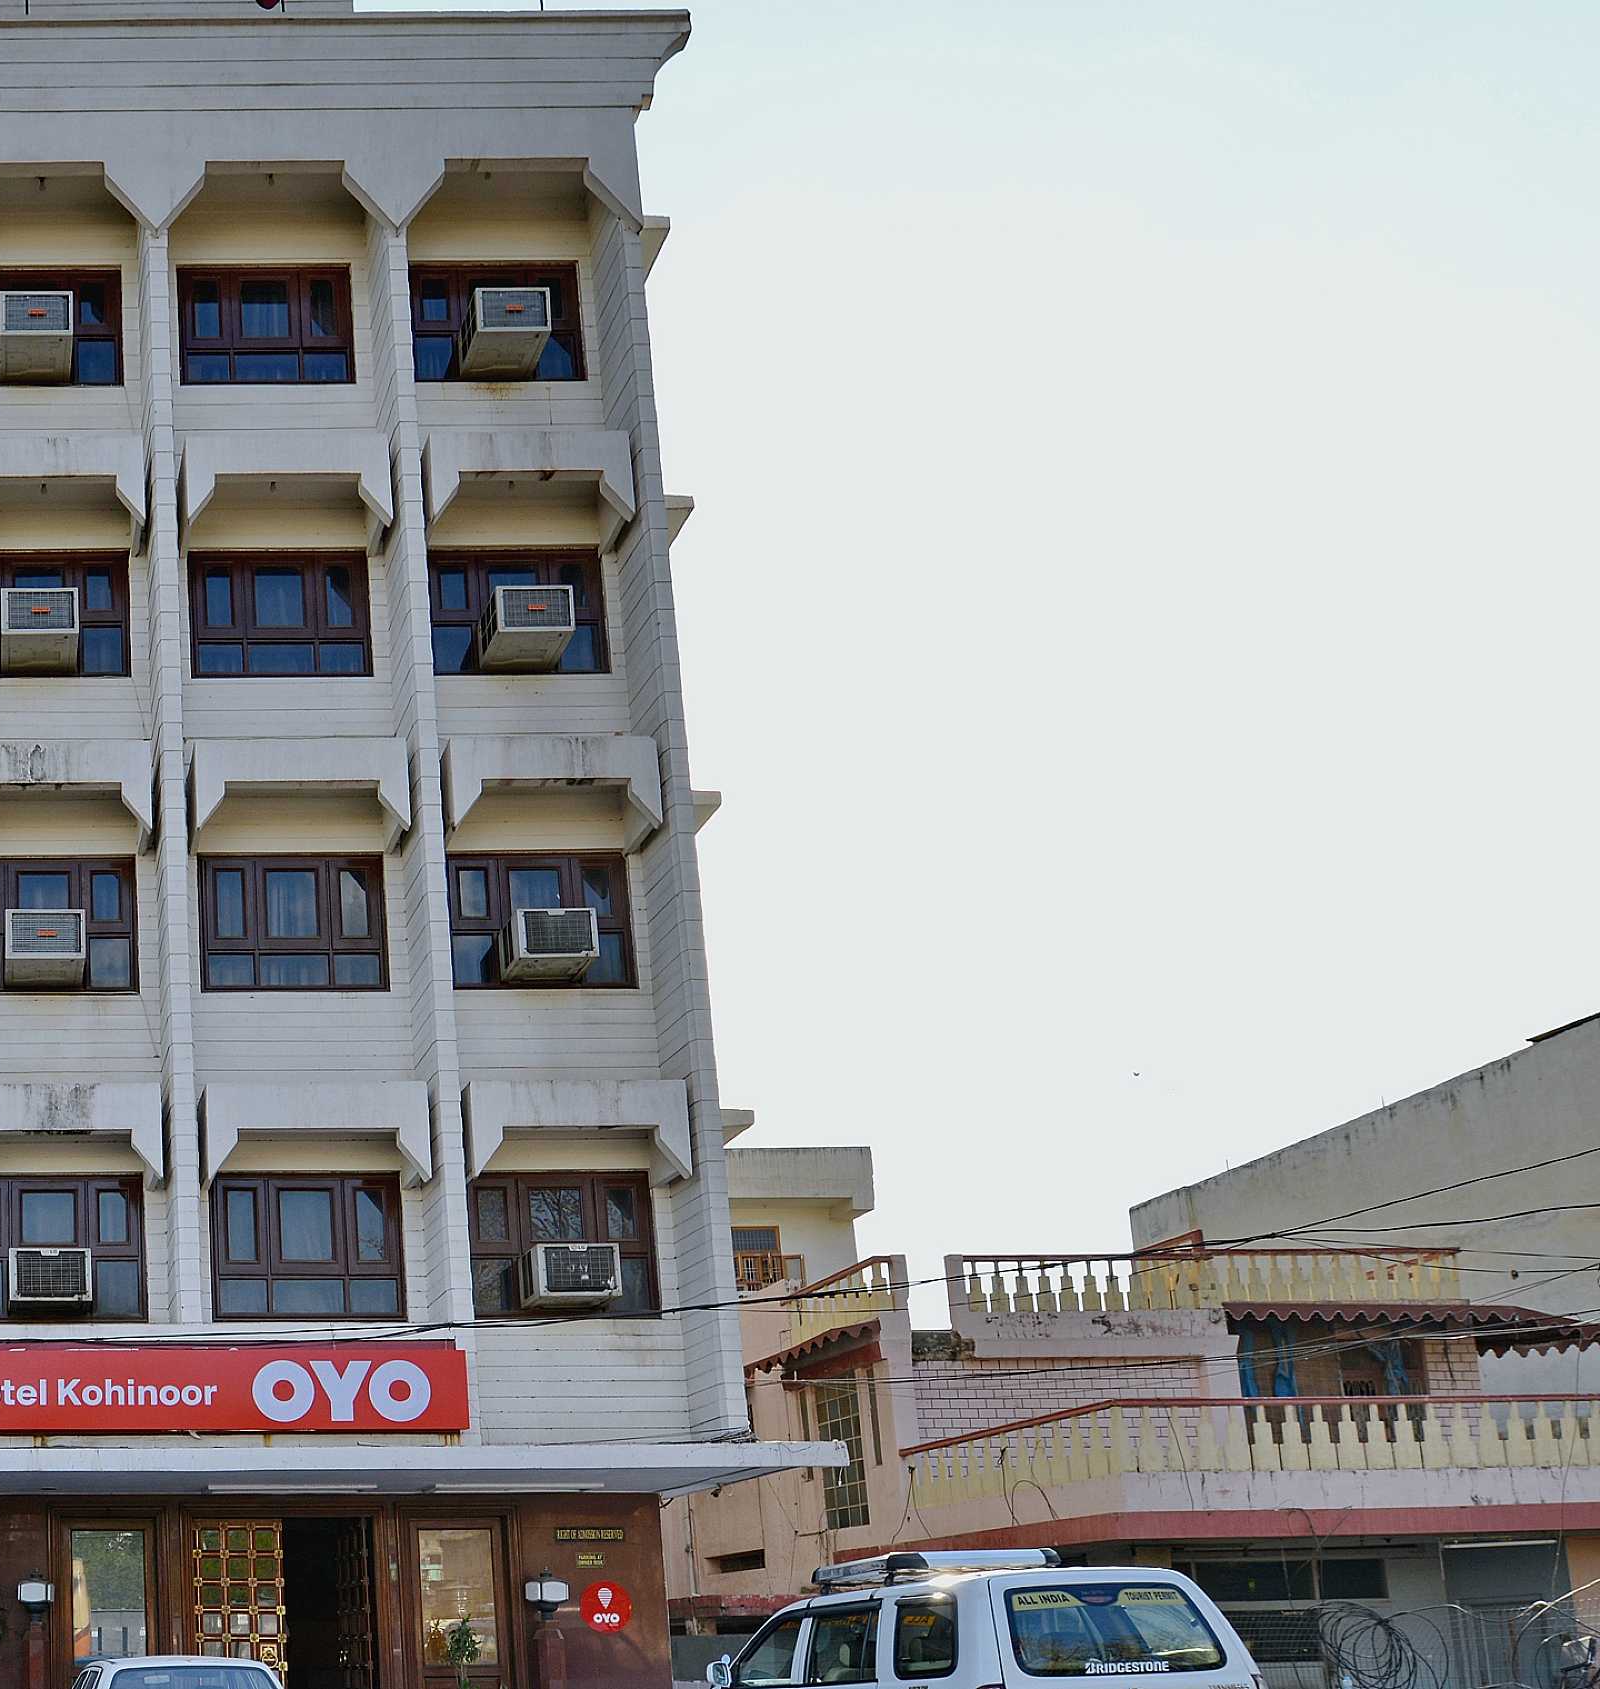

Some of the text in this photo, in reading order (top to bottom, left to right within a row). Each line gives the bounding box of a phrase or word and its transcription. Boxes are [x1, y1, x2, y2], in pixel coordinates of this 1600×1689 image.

[57, 1378, 218, 1406] Kohinoor
[251, 1359, 432, 1422] OYO
[1018, 1596, 1038, 1606] ALL
[1041, 1593, 1071, 1604] INDIA
[593, 1612, 620, 1624] OYO
[1085, 1660, 1170, 1674] BRIDGESTONE
